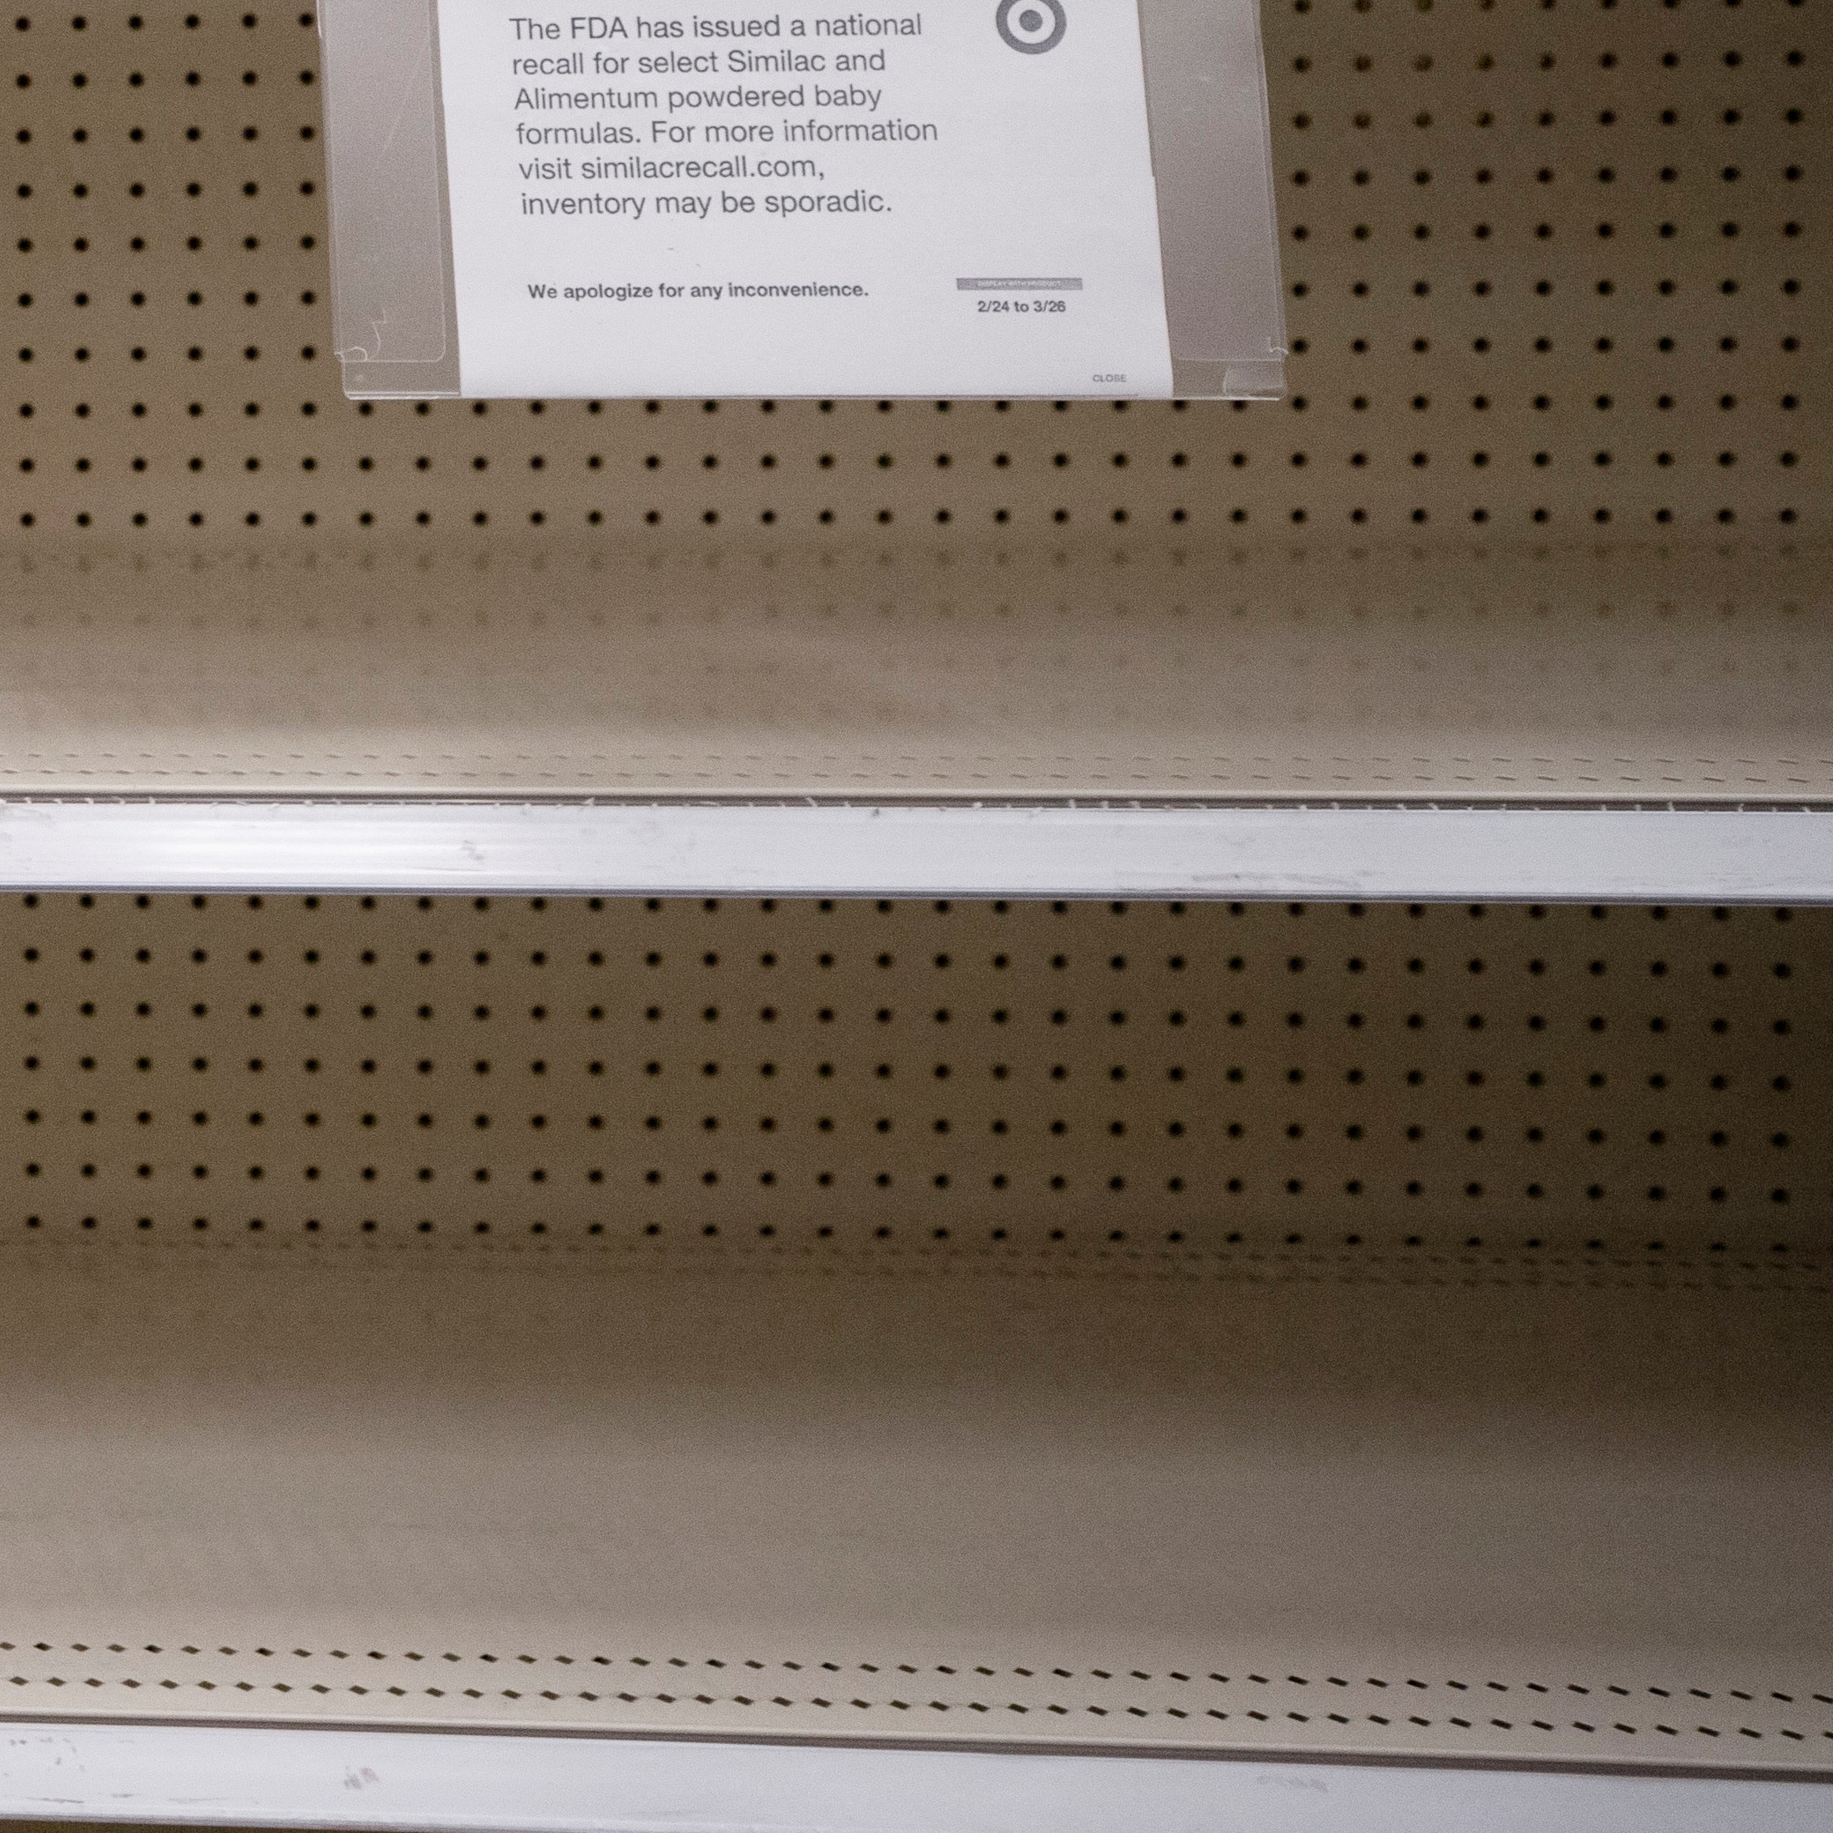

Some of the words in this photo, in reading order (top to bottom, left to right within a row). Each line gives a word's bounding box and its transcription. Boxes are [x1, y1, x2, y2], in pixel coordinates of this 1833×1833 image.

[509, 18, 560, 40] The
[571, 16, 628, 39] FDA
[636, 16, 684, 38] has
[693, 14, 780, 38] issued
[790, 19, 806, 37] a
[815, 13, 921, 36] national
[513, 52, 584, 75] recall
[593, 51, 630, 74] for
[638, 51, 719, 73] select
[728, 49, 826, 73] Similac
[835, 49, 885, 71] and
[514, 87, 658, 110] Alimentum
[668, 84, 805, 114] powdered
[815, 84, 882, 112] baby
[516, 121, 641, 145] formulas.
[652, 120, 695, 143] For
[705, 125, 774, 143] more
[783, 118, 938, 142] information
[519, 157, 573, 180] visit
[581, 155, 824, 180] similacrecall.com,
[521, 193, 646, 220] inventory
[656, 196, 712, 219] may
[721, 190, 755, 213] be
[765, 189, 892, 218] sporadic.
[527, 284, 558, 299] We
[564, 283, 653, 302] apologize
[658, 283, 685, 298] for
[690, 286, 723, 303] any
[728, 282, 869, 297] inconvenience.
[978, 301, 1009, 312] 2/24
[1015, 301, 1029, 312] to
[1034, 301, 1066, 312] 3/26
[1093, 374, 1126, 382] CLOSE
